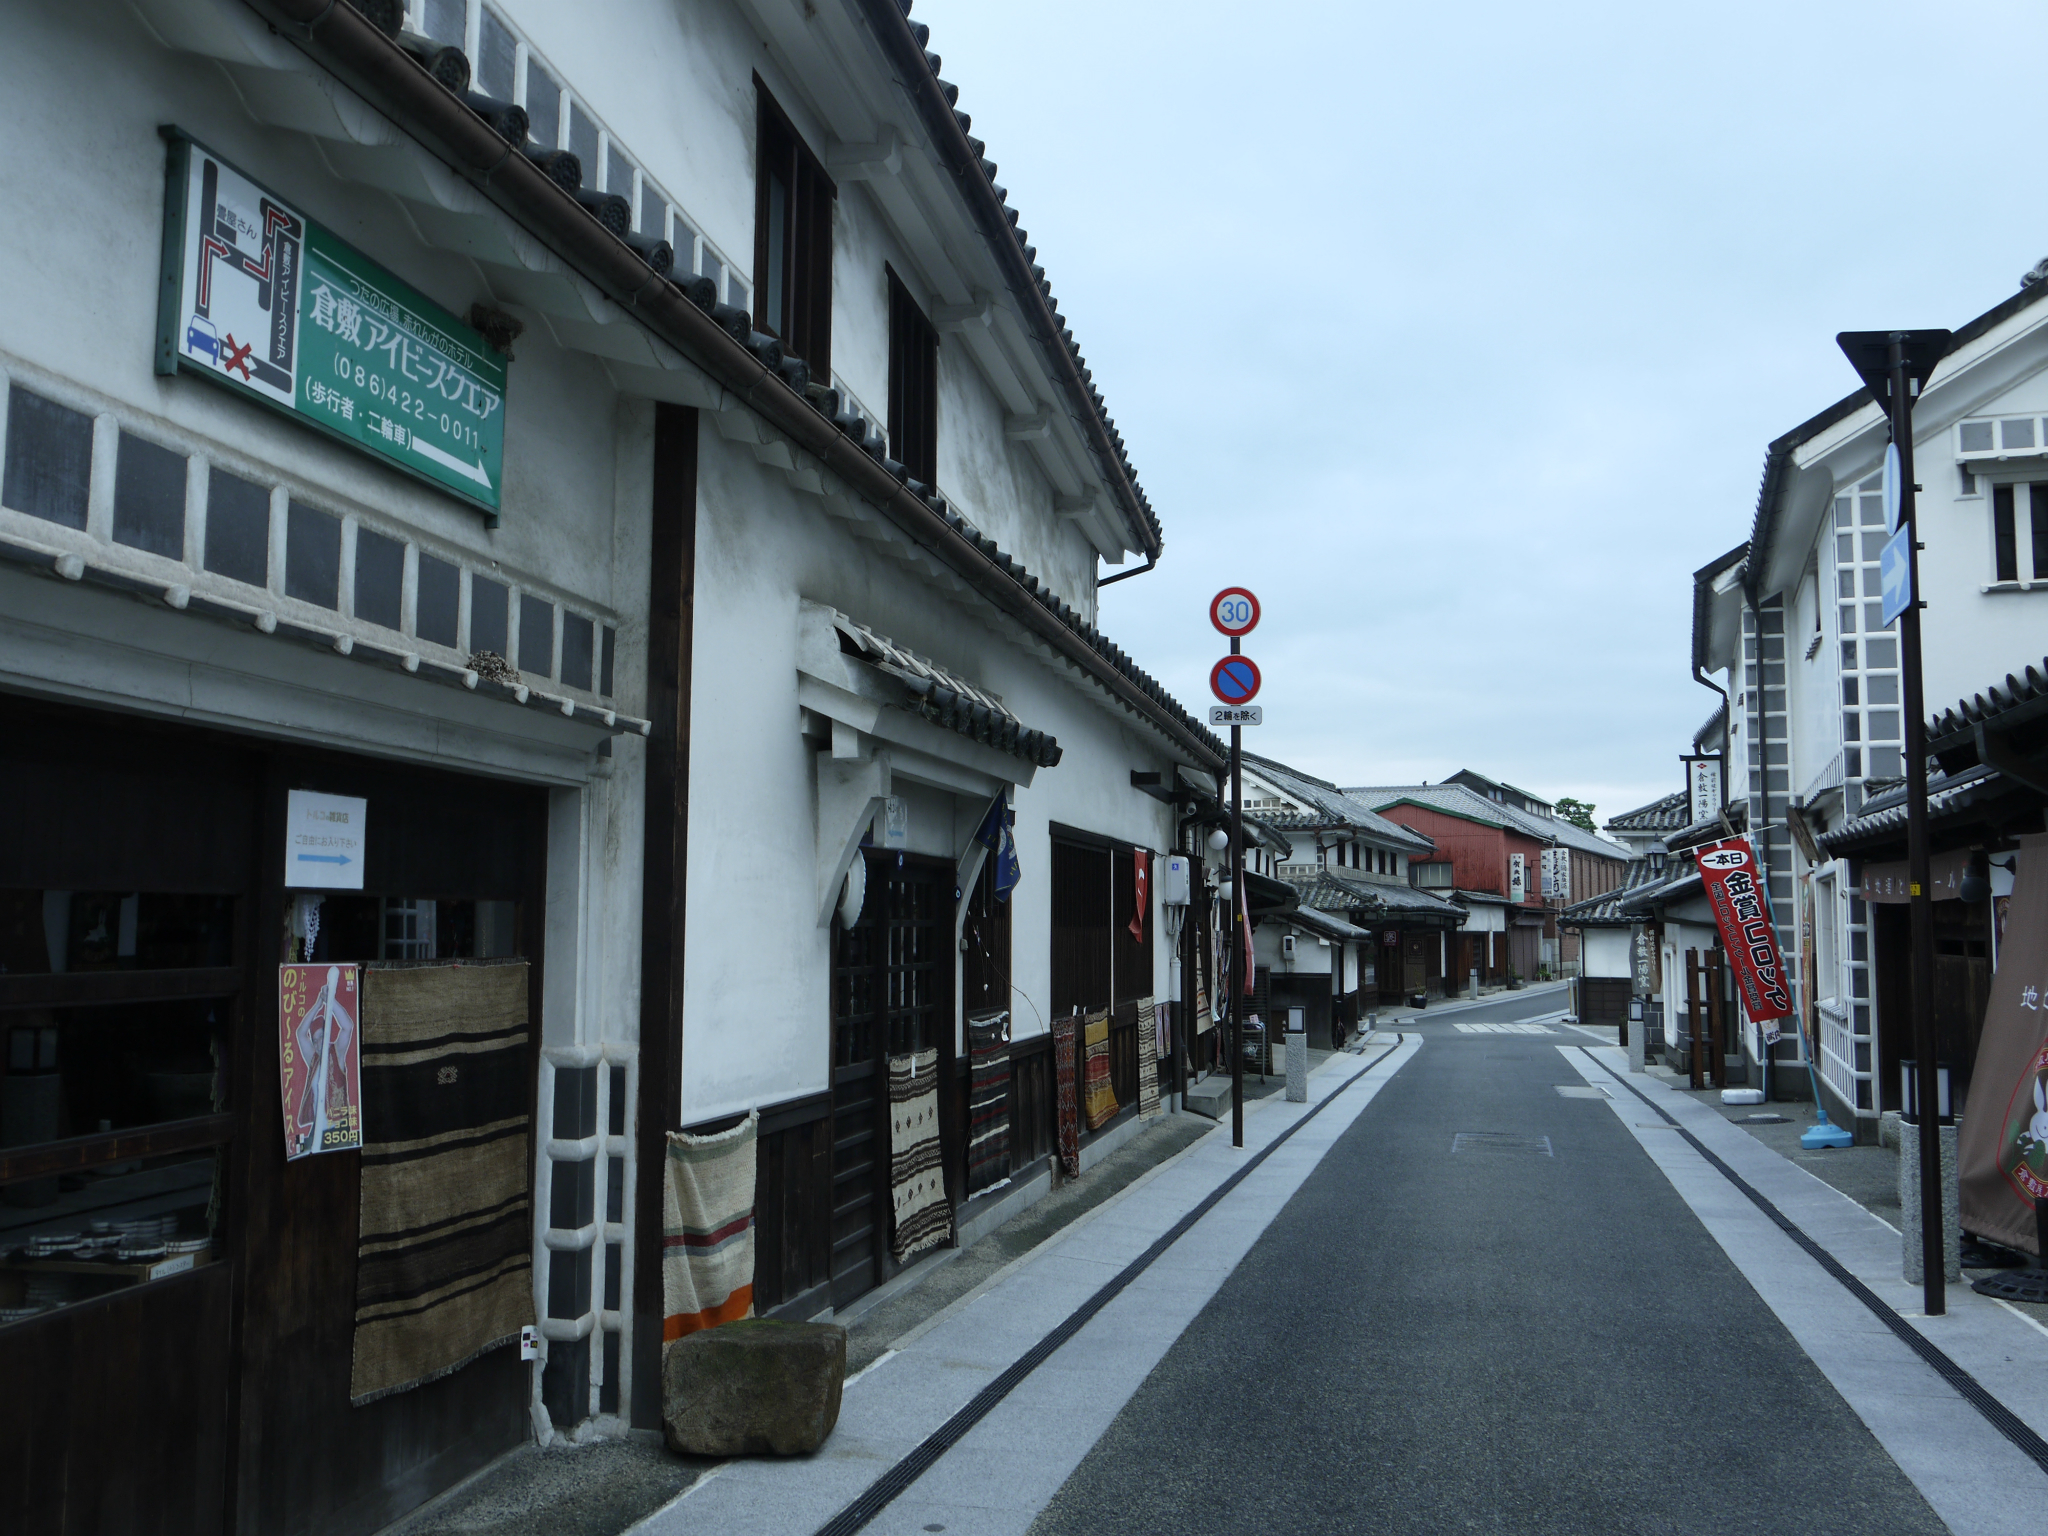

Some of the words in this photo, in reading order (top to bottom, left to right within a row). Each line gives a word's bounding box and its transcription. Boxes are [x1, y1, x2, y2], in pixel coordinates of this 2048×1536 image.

[216, 203, 258, 240] 畳屋さん
[276, 240, 293, 360] 倉敷アイビースクエア
[309, 283, 501, 420] 倉敷アイビースクエア
[304, 375, 413, 451] (歩行者・二輪車)
[333, 351, 478, 450] (086)422-0011
[1222, 601, 1248, 622] 30
[1214, 710, 1257, 721] 2輪を除く
[306, 808, 350, 824] トルコの雑貨店
[295, 833, 357, 849] ご自由にお入り下さい
[1636, 932, 1649, 987] 倉敷一陽窯
[297, 968, 307, 1018] トルコの
[326, 1105, 358, 1117] バニラ味
[326, 1117, 358, 1129] チョコ味
[324, 1130, 359, 1145] 350円
